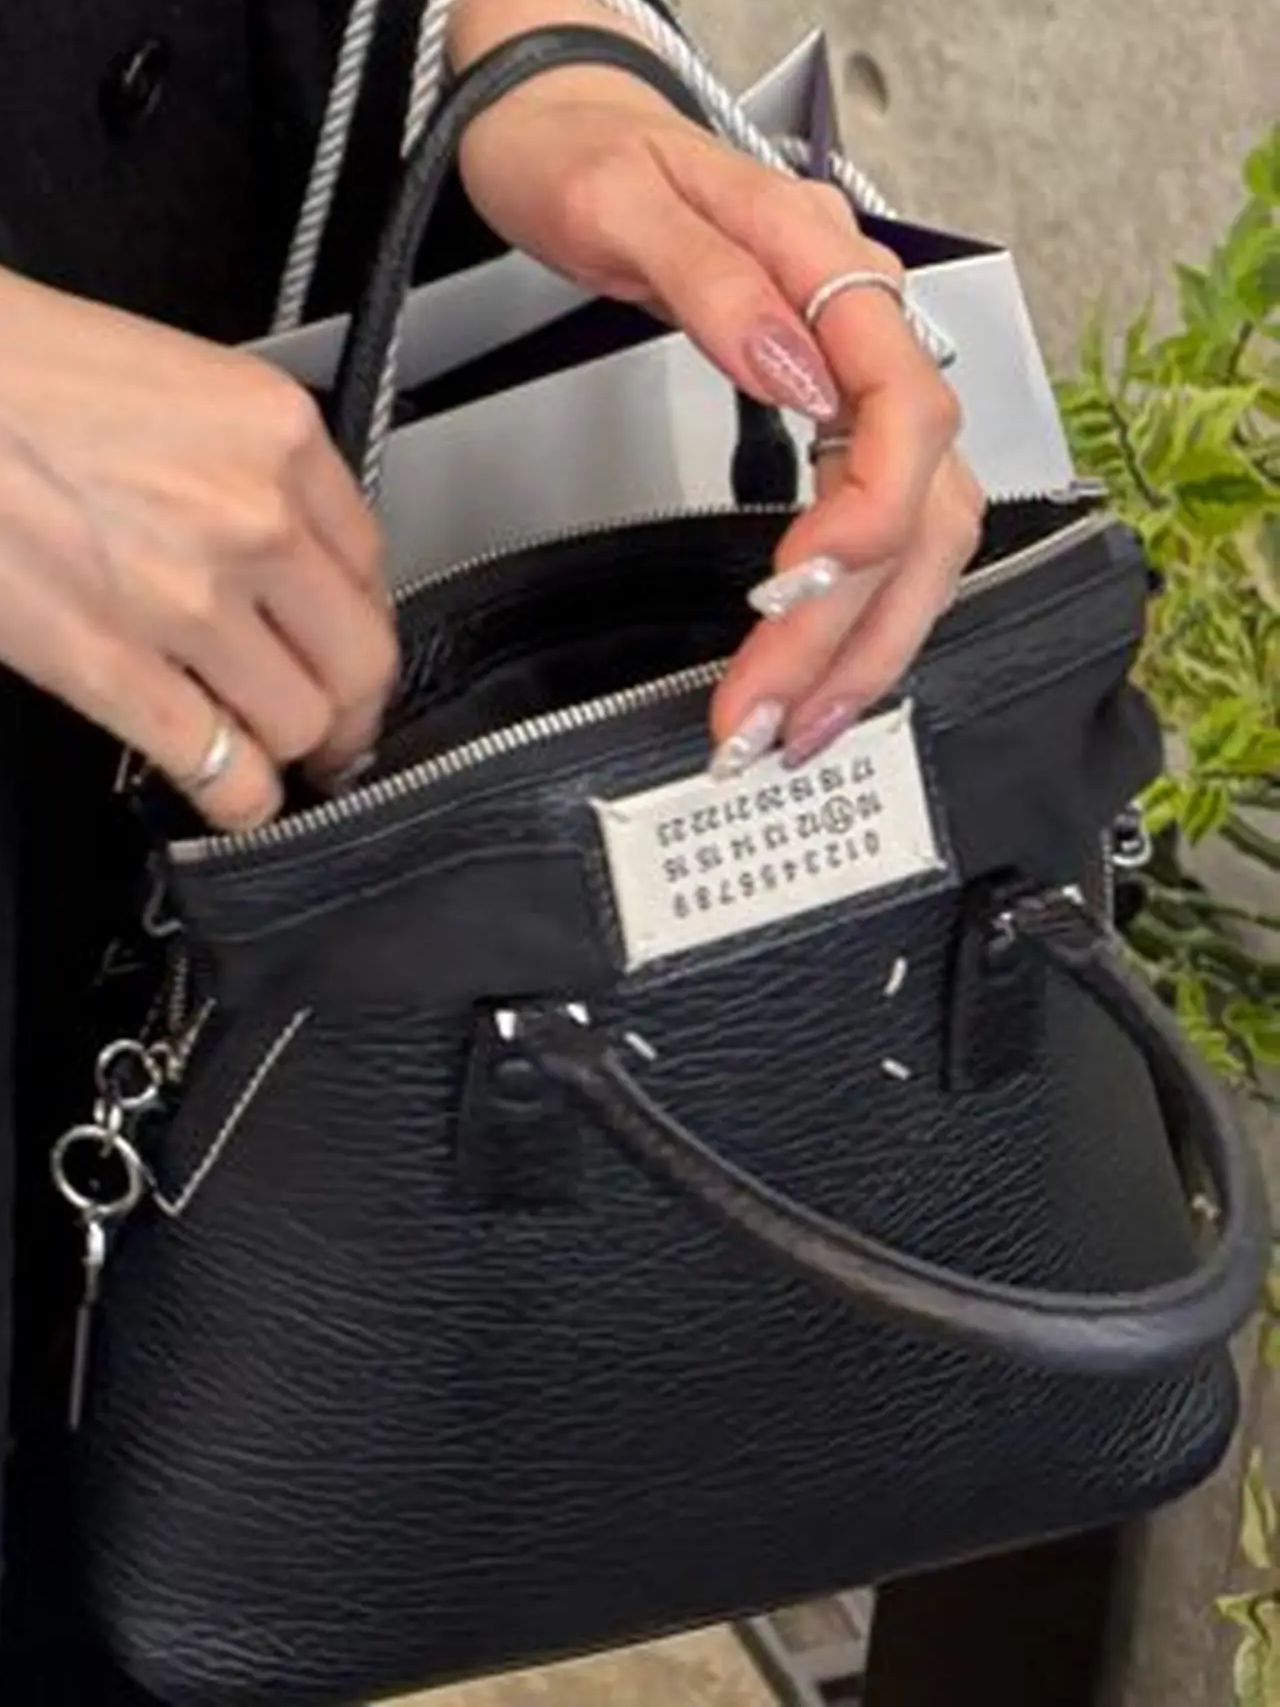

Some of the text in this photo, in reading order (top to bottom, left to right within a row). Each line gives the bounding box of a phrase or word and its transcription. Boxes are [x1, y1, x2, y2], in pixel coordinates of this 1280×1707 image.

[851, 754, 876, 783] 17
[755, 785, 785, 811] 20
[789, 776, 814, 801] 19
[690, 806, 721, 836] 22
[724, 795, 752, 824] 21
[656, 817, 687, 848] 23
[763, 825, 789, 850] 13
[795, 811, 822, 840] 12
[730, 834, 757, 861] 14
[827, 843, 842, 868] 2
[846, 840, 858, 861] 1
[865, 831, 879, 856] 0
[782, 860, 797, 881] 4
[804, 850, 820, 875] 3
[741, 872, 754, 897] 6
[761, 864, 777, 890] 5
[696, 886, 710, 910] 8
[719, 879, 736, 906] 7
